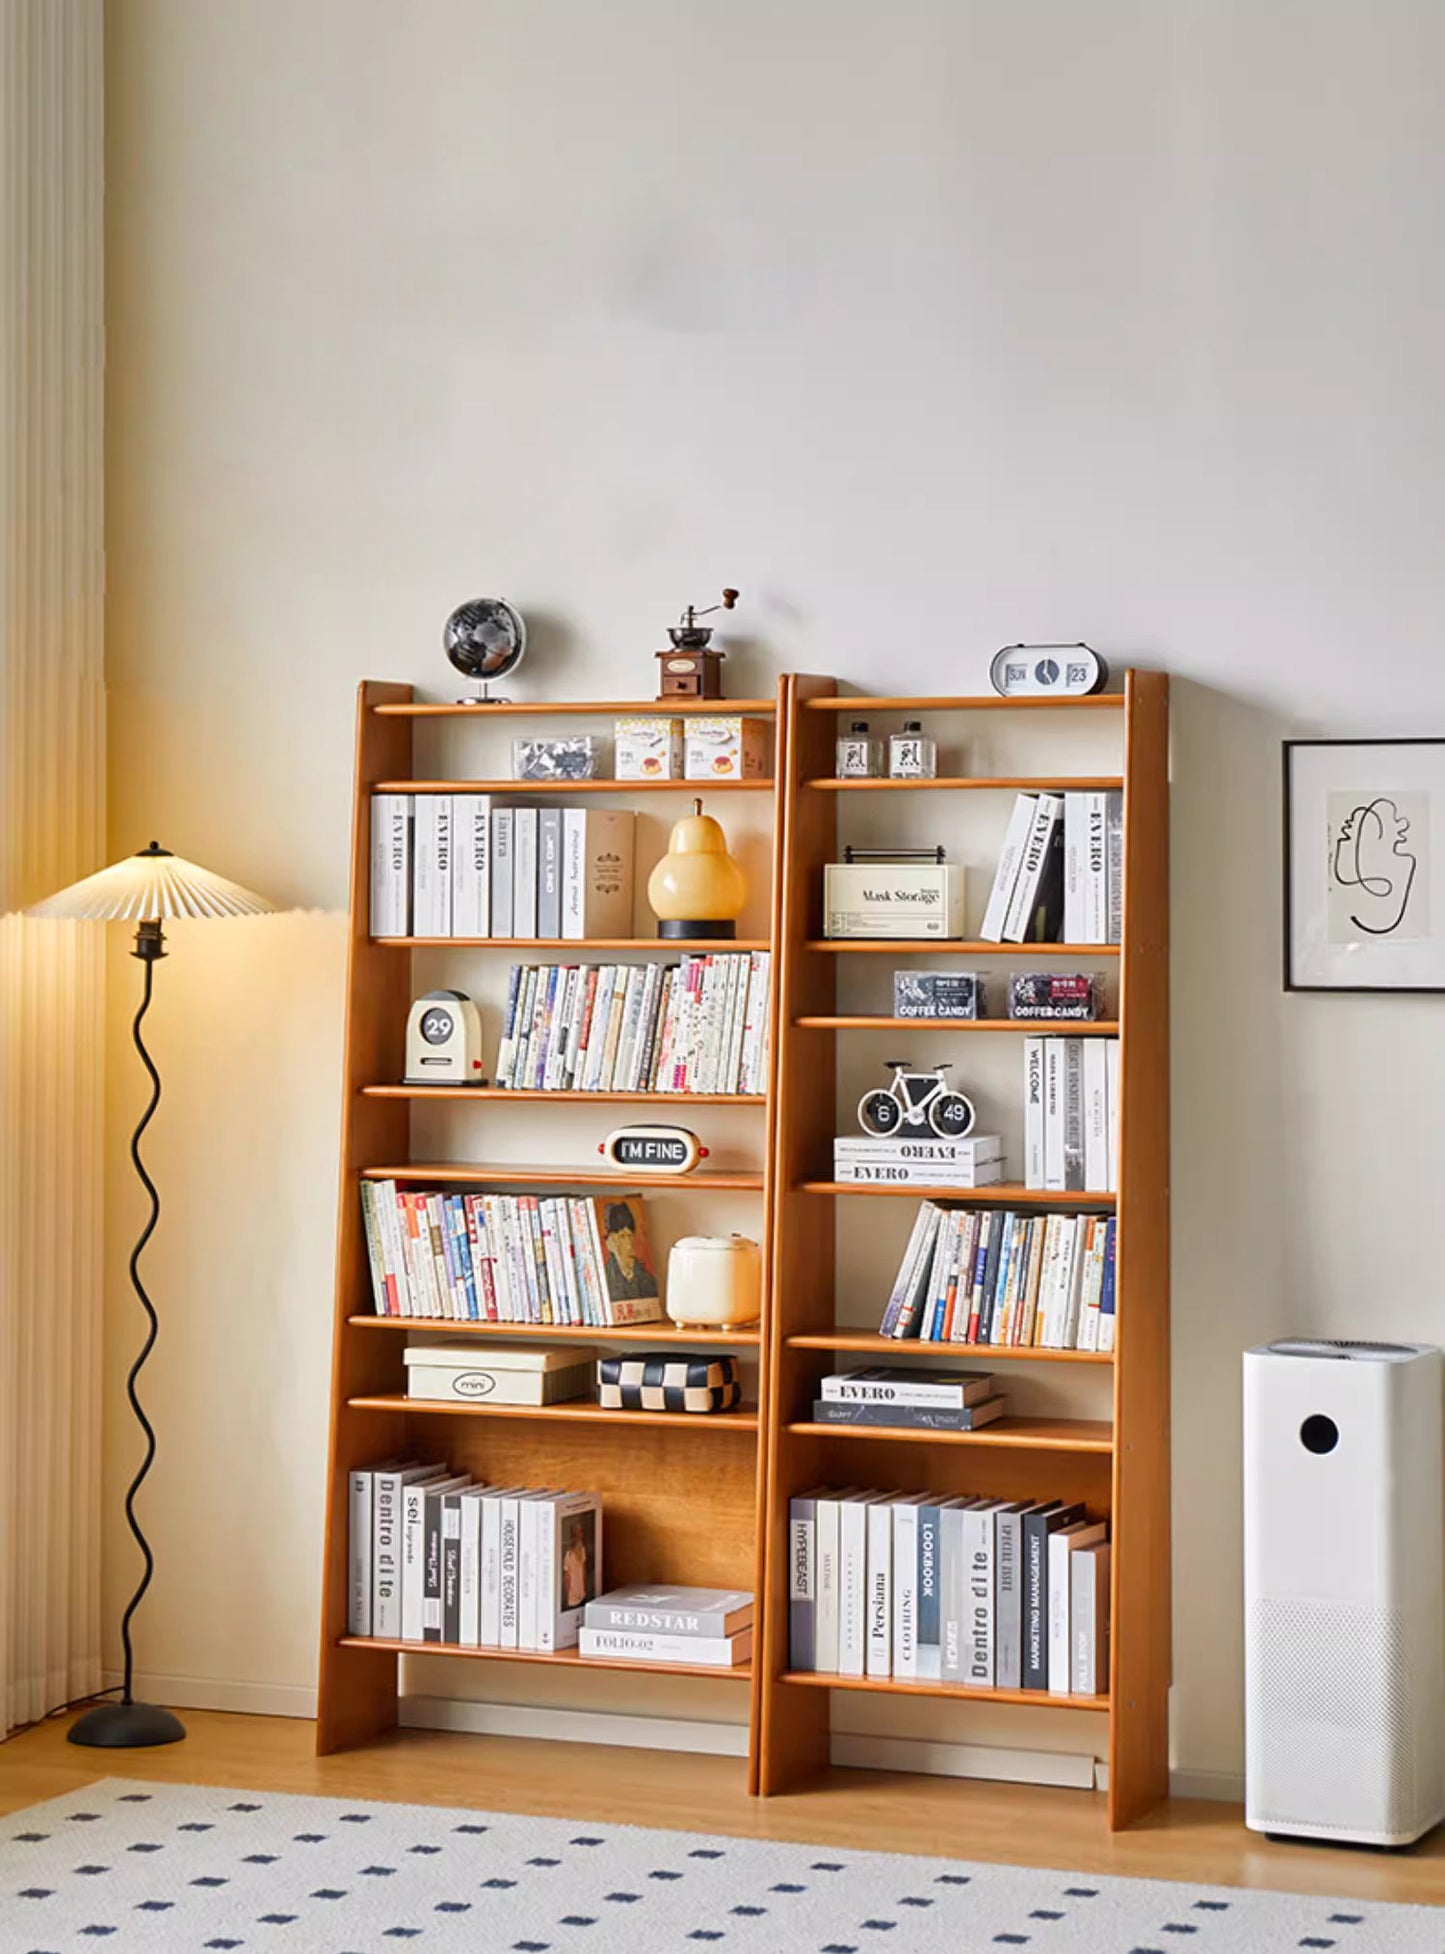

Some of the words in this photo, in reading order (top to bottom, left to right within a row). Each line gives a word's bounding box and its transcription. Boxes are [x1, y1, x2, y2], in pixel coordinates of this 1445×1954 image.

[1071, 668, 1087, 682] 23
[393, 815, 404, 871] EVERO
[437, 815, 448, 871] EVERO
[474, 815, 486, 871] EVERO
[1026, 812, 1051, 873] EVERO
[1090, 812, 1102, 873] EVERO
[863, 889, 891, 902] Mask
[894, 890, 939, 904] Storage
[899, 1005, 936, 1016] COFFEE
[937, 1005, 972, 1016] CANDY
[1015, 1005, 1053, 1017] COFFEE
[1054, 1005, 1089, 1018] CANDY
[426, 1018, 452, 1036] 29
[1030, 1049, 1041, 1104] WELCOME
[877, 1105, 890, 1122] 6
[943, 1103, 965, 1121] 49
[621, 1141, 642, 1158] I'M
[645, 1142, 683, 1159] FINE
[900, 1145, 956, 1159] EVERO
[854, 1166, 909, 1180] EVERO
[460, 1378, 486, 1390] mini
[840, 1386, 896, 1400] EVERO
[379, 1479, 394, 1546] Dentro
[407, 1496, 421, 1525] sei
[503, 1519, 515, 1572] HOUSEHOLD
[379, 1554, 394, 1575] di
[796, 1523, 808, 1595] HYPEBEAST
[922, 1523, 933, 1597] LOOKBOOK
[971, 1551, 988, 1572] te
[1030, 1534, 1040, 1607] MANAGEMENT
[379, 1580, 394, 1598] te
[971, 1575, 988, 1598] di
[503, 1575, 515, 1628] DECORATES
[872, 1572, 886, 1639] Persiana
[609, 1610, 699, 1631] REDSTAR
[903, 1589, 912, 1661] CLOTHING
[595, 1635, 654, 1651] FOLIO-02
[971, 1608, 988, 1678] Dentro
[1030, 1608, 1040, 1670] MARKETING
